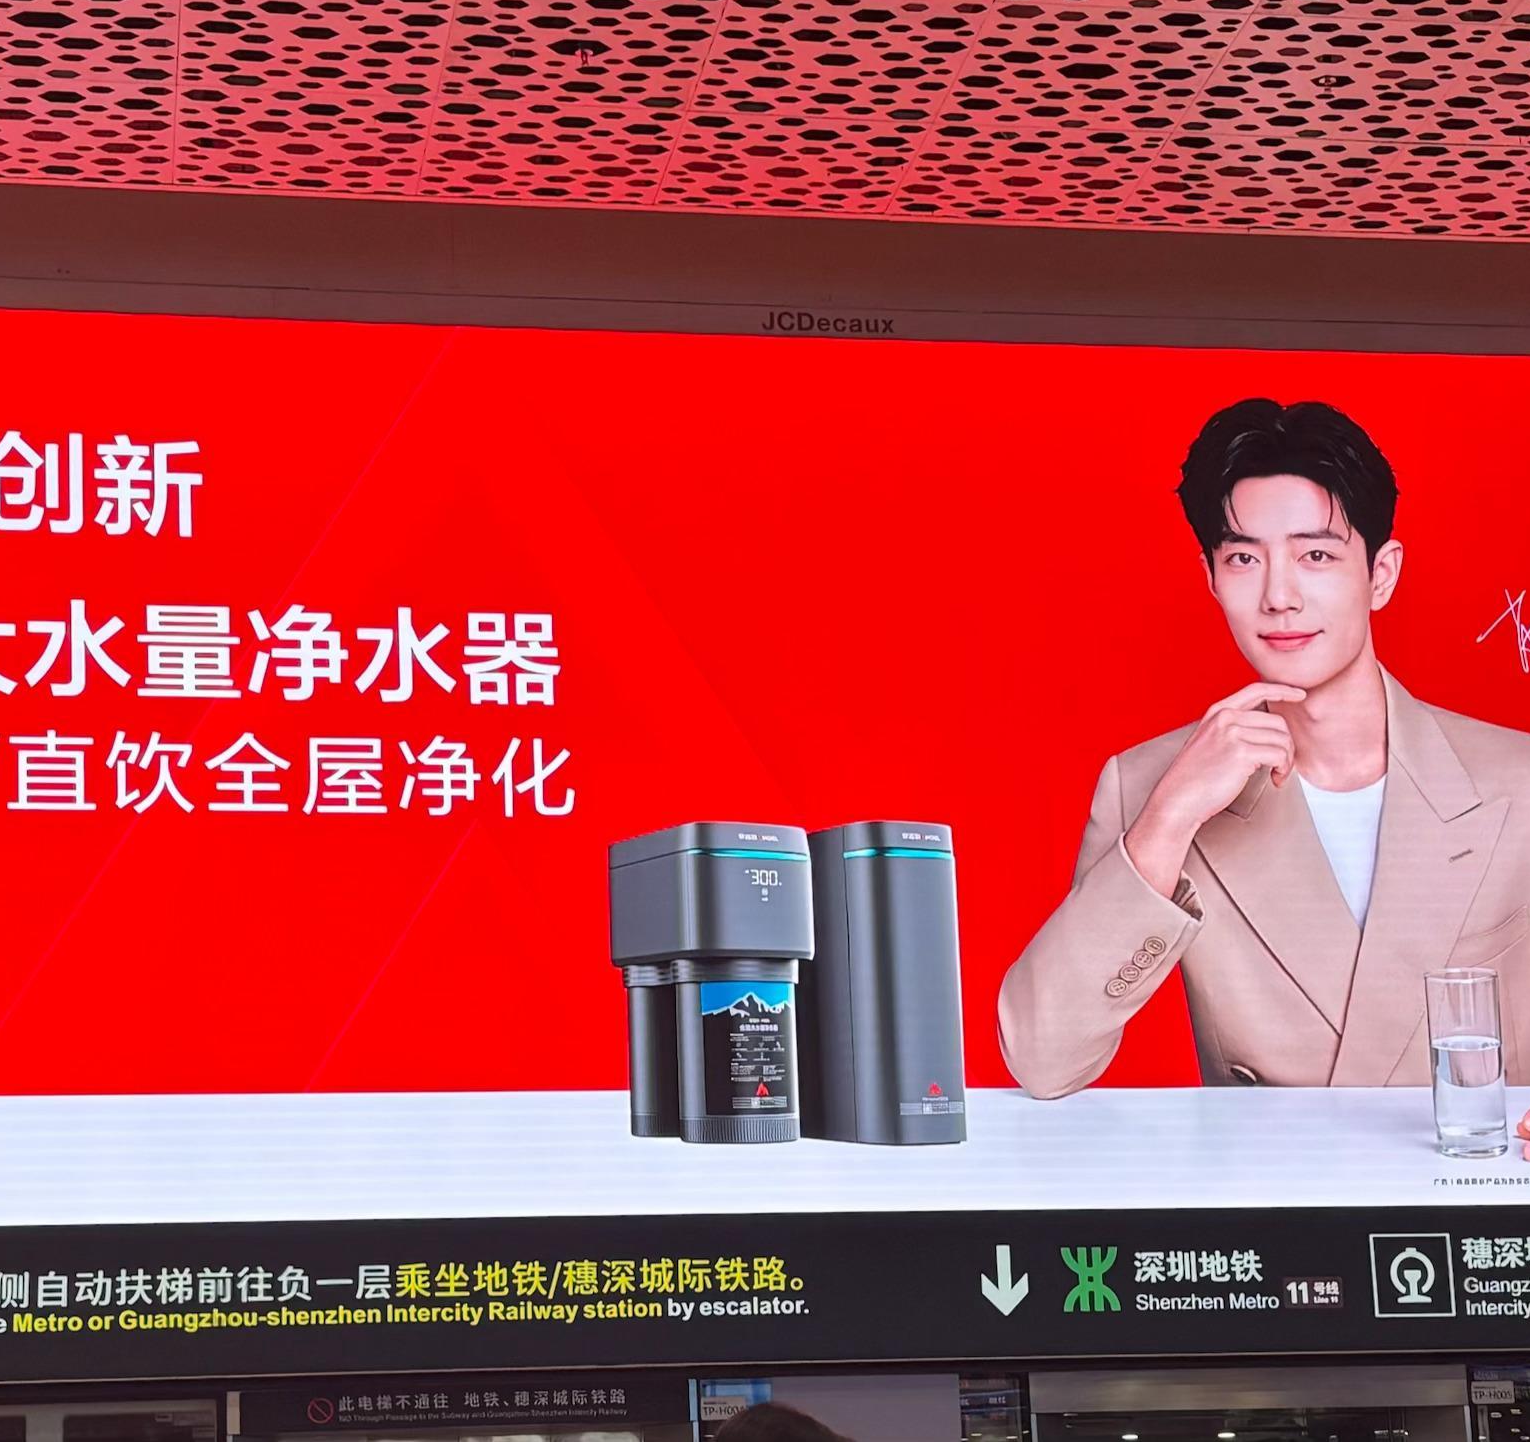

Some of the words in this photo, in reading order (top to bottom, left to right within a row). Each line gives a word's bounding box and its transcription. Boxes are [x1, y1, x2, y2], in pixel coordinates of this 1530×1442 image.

[761, 311, 895, 334] JCDecaux
[1133, 1249, 1264, 1284] 深圳地铁
[1135, 1292, 1225, 1312] Shenzhen
[1228, 1290, 1280, 1311] Metro
[1286, 1281, 1309, 1304] 11
[1313, 1280, 1340, 1296] 号线
[11, 1311, 83, 1333] Metro
[87, 1313, 114, 1332] or
[118, 1304, 381, 1332] Guangzhou-shenzhen
[385, 1301, 483, 1327] Intercity
[488, 1299, 578, 1325] Railway
[582, 1297, 663, 1319] station
[667, 1297, 694, 1320] by
[699, 1295, 810, 1317] escalator.
[338, 1392, 449, 1413] 此电梯不通往
[464, 1388, 627, 1409] 地铁、穗深城际铁路
